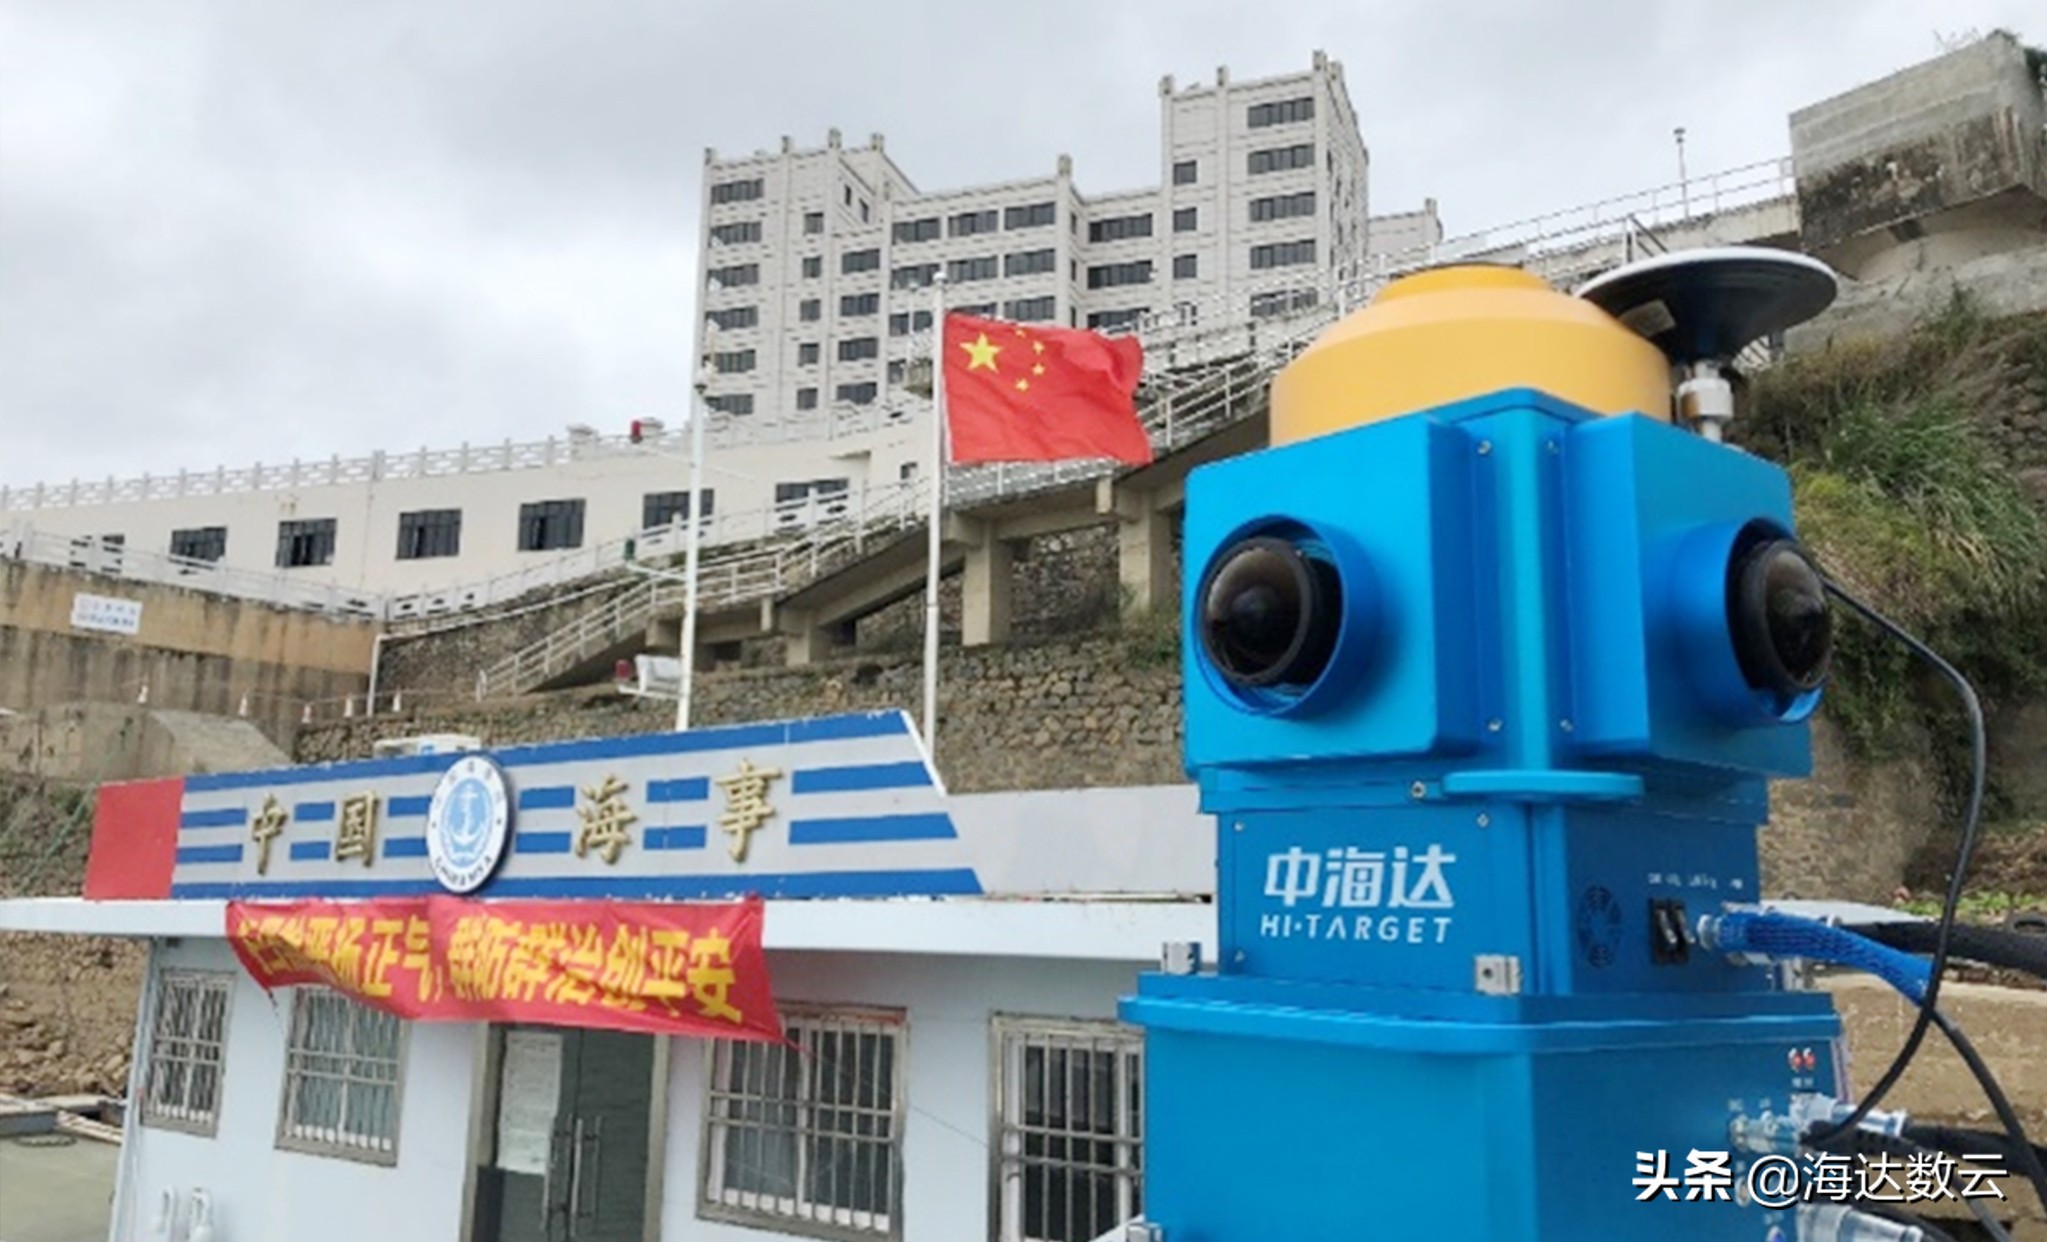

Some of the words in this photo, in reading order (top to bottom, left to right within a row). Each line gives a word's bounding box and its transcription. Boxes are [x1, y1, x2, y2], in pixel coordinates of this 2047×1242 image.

[250, 789, 382, 876] 中国
[574, 759, 783, 865] 海事
[1264, 844, 1456, 908] 中海达
